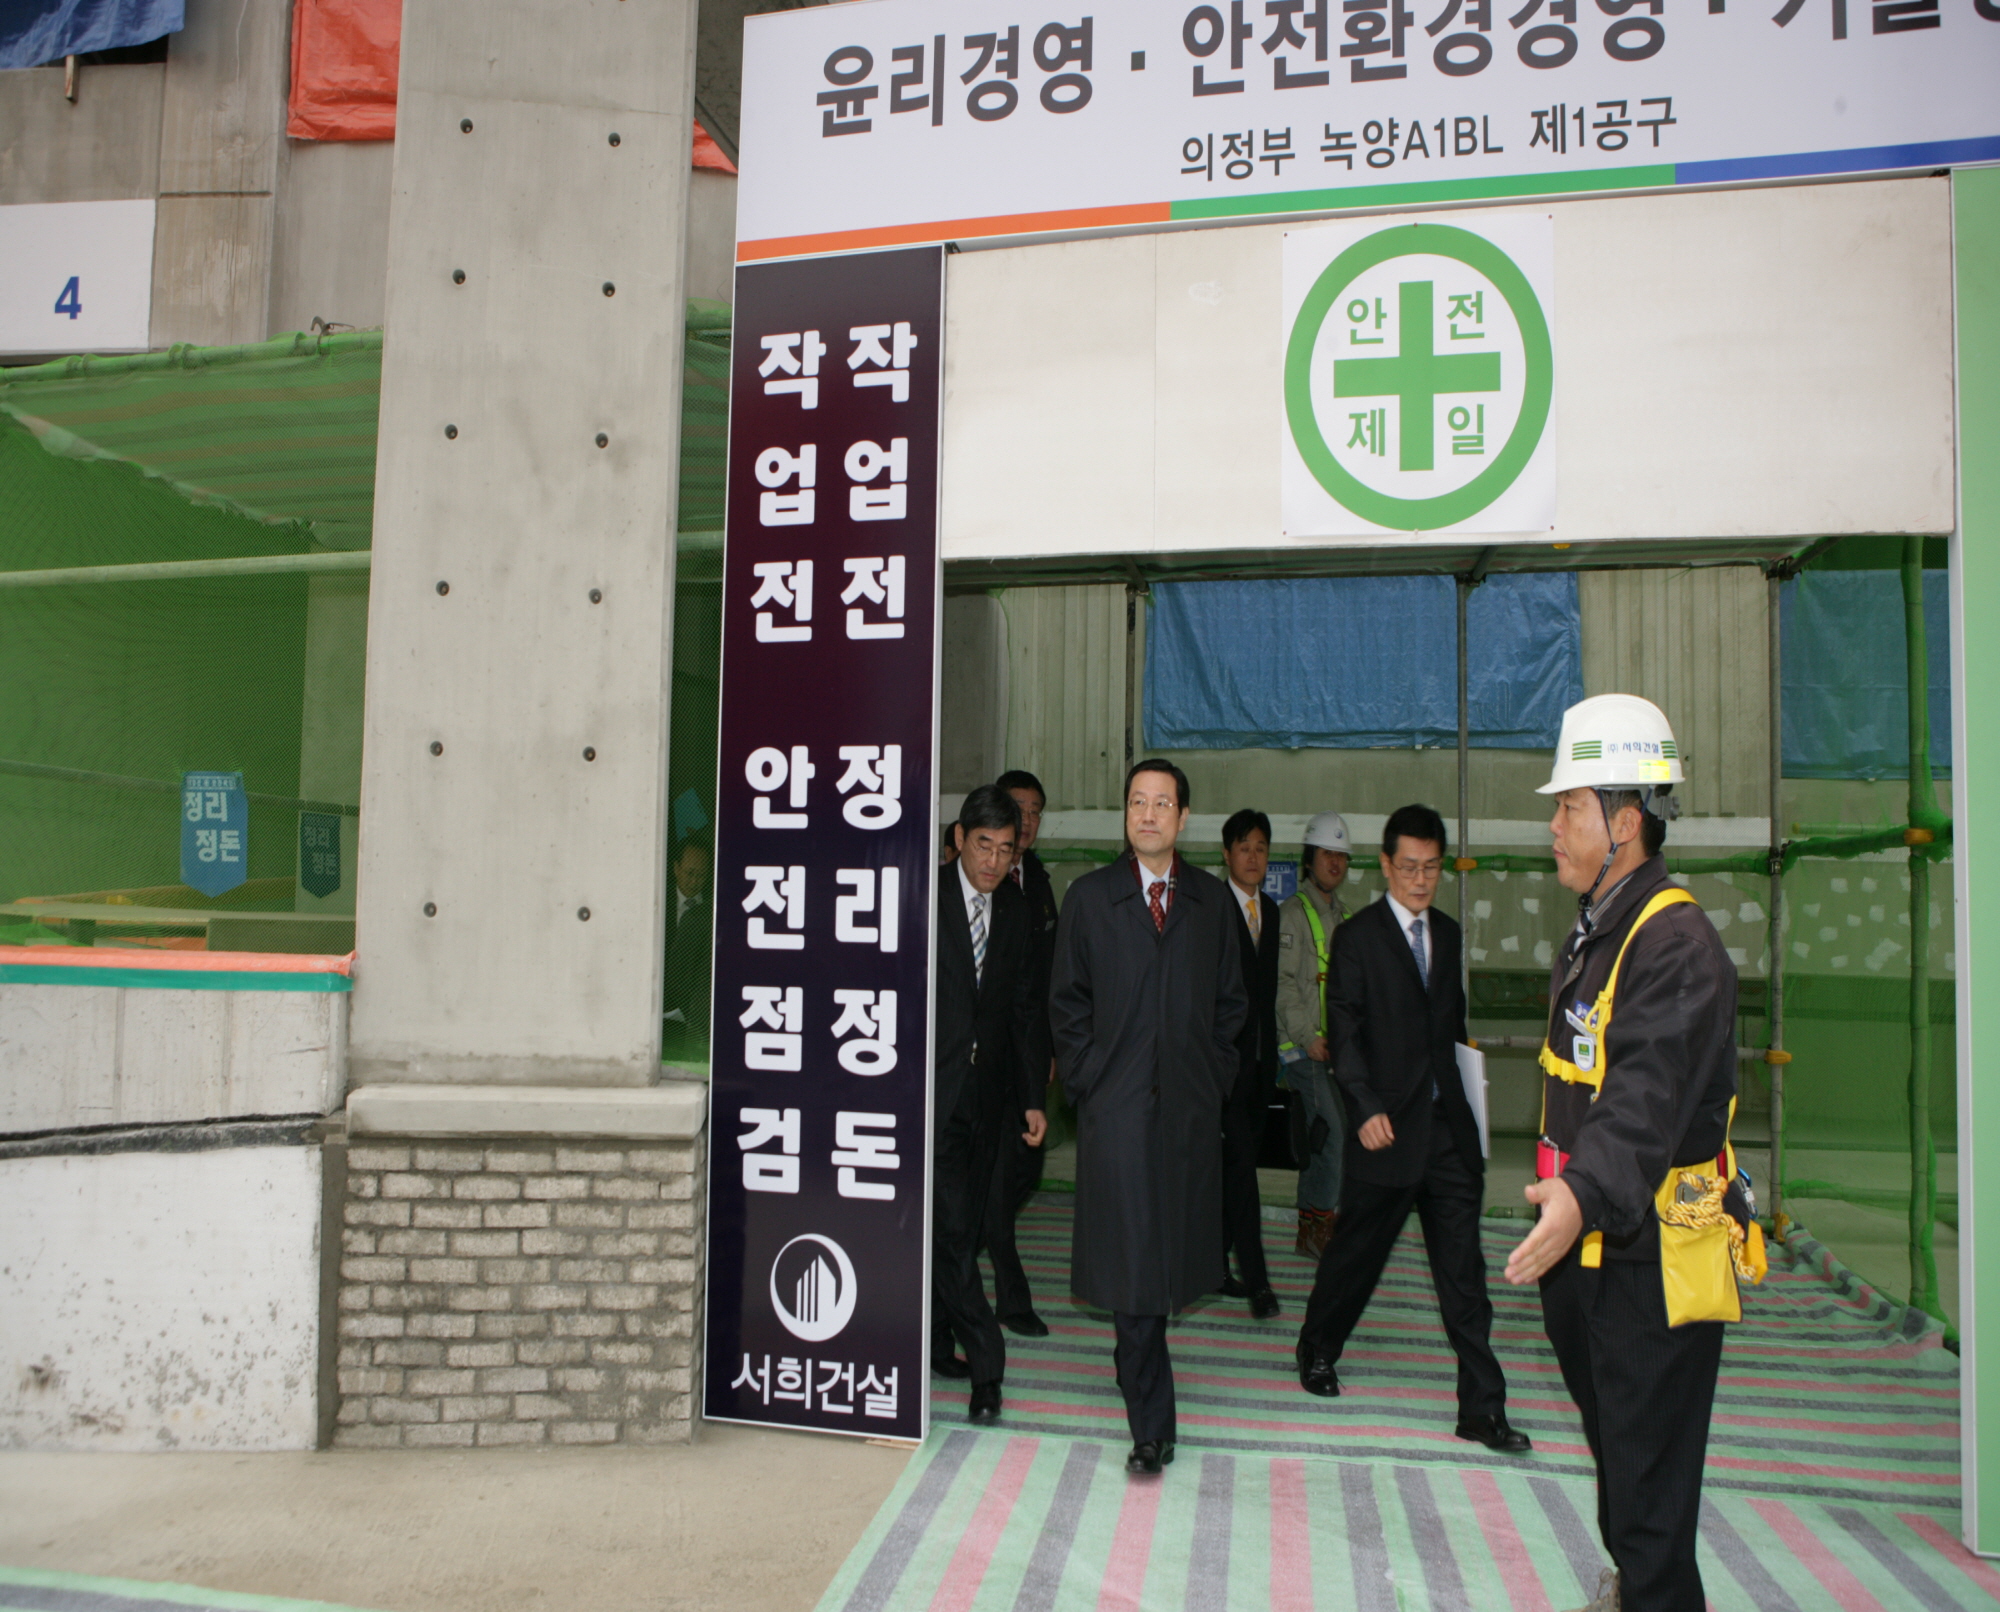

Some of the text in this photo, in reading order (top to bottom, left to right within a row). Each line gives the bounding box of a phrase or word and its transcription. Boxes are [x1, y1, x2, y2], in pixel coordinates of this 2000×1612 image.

[816, 17, 1094, 138] 윤리경영
[1181, 97, 1677, 182] 의정부 녹양A1BL 제1공구
[54, 276, 82, 320] 4
[185, 792, 228, 822] 정리
[196, 830, 240, 862] 정돈
[731, 1353, 898, 1419] 서희건설
